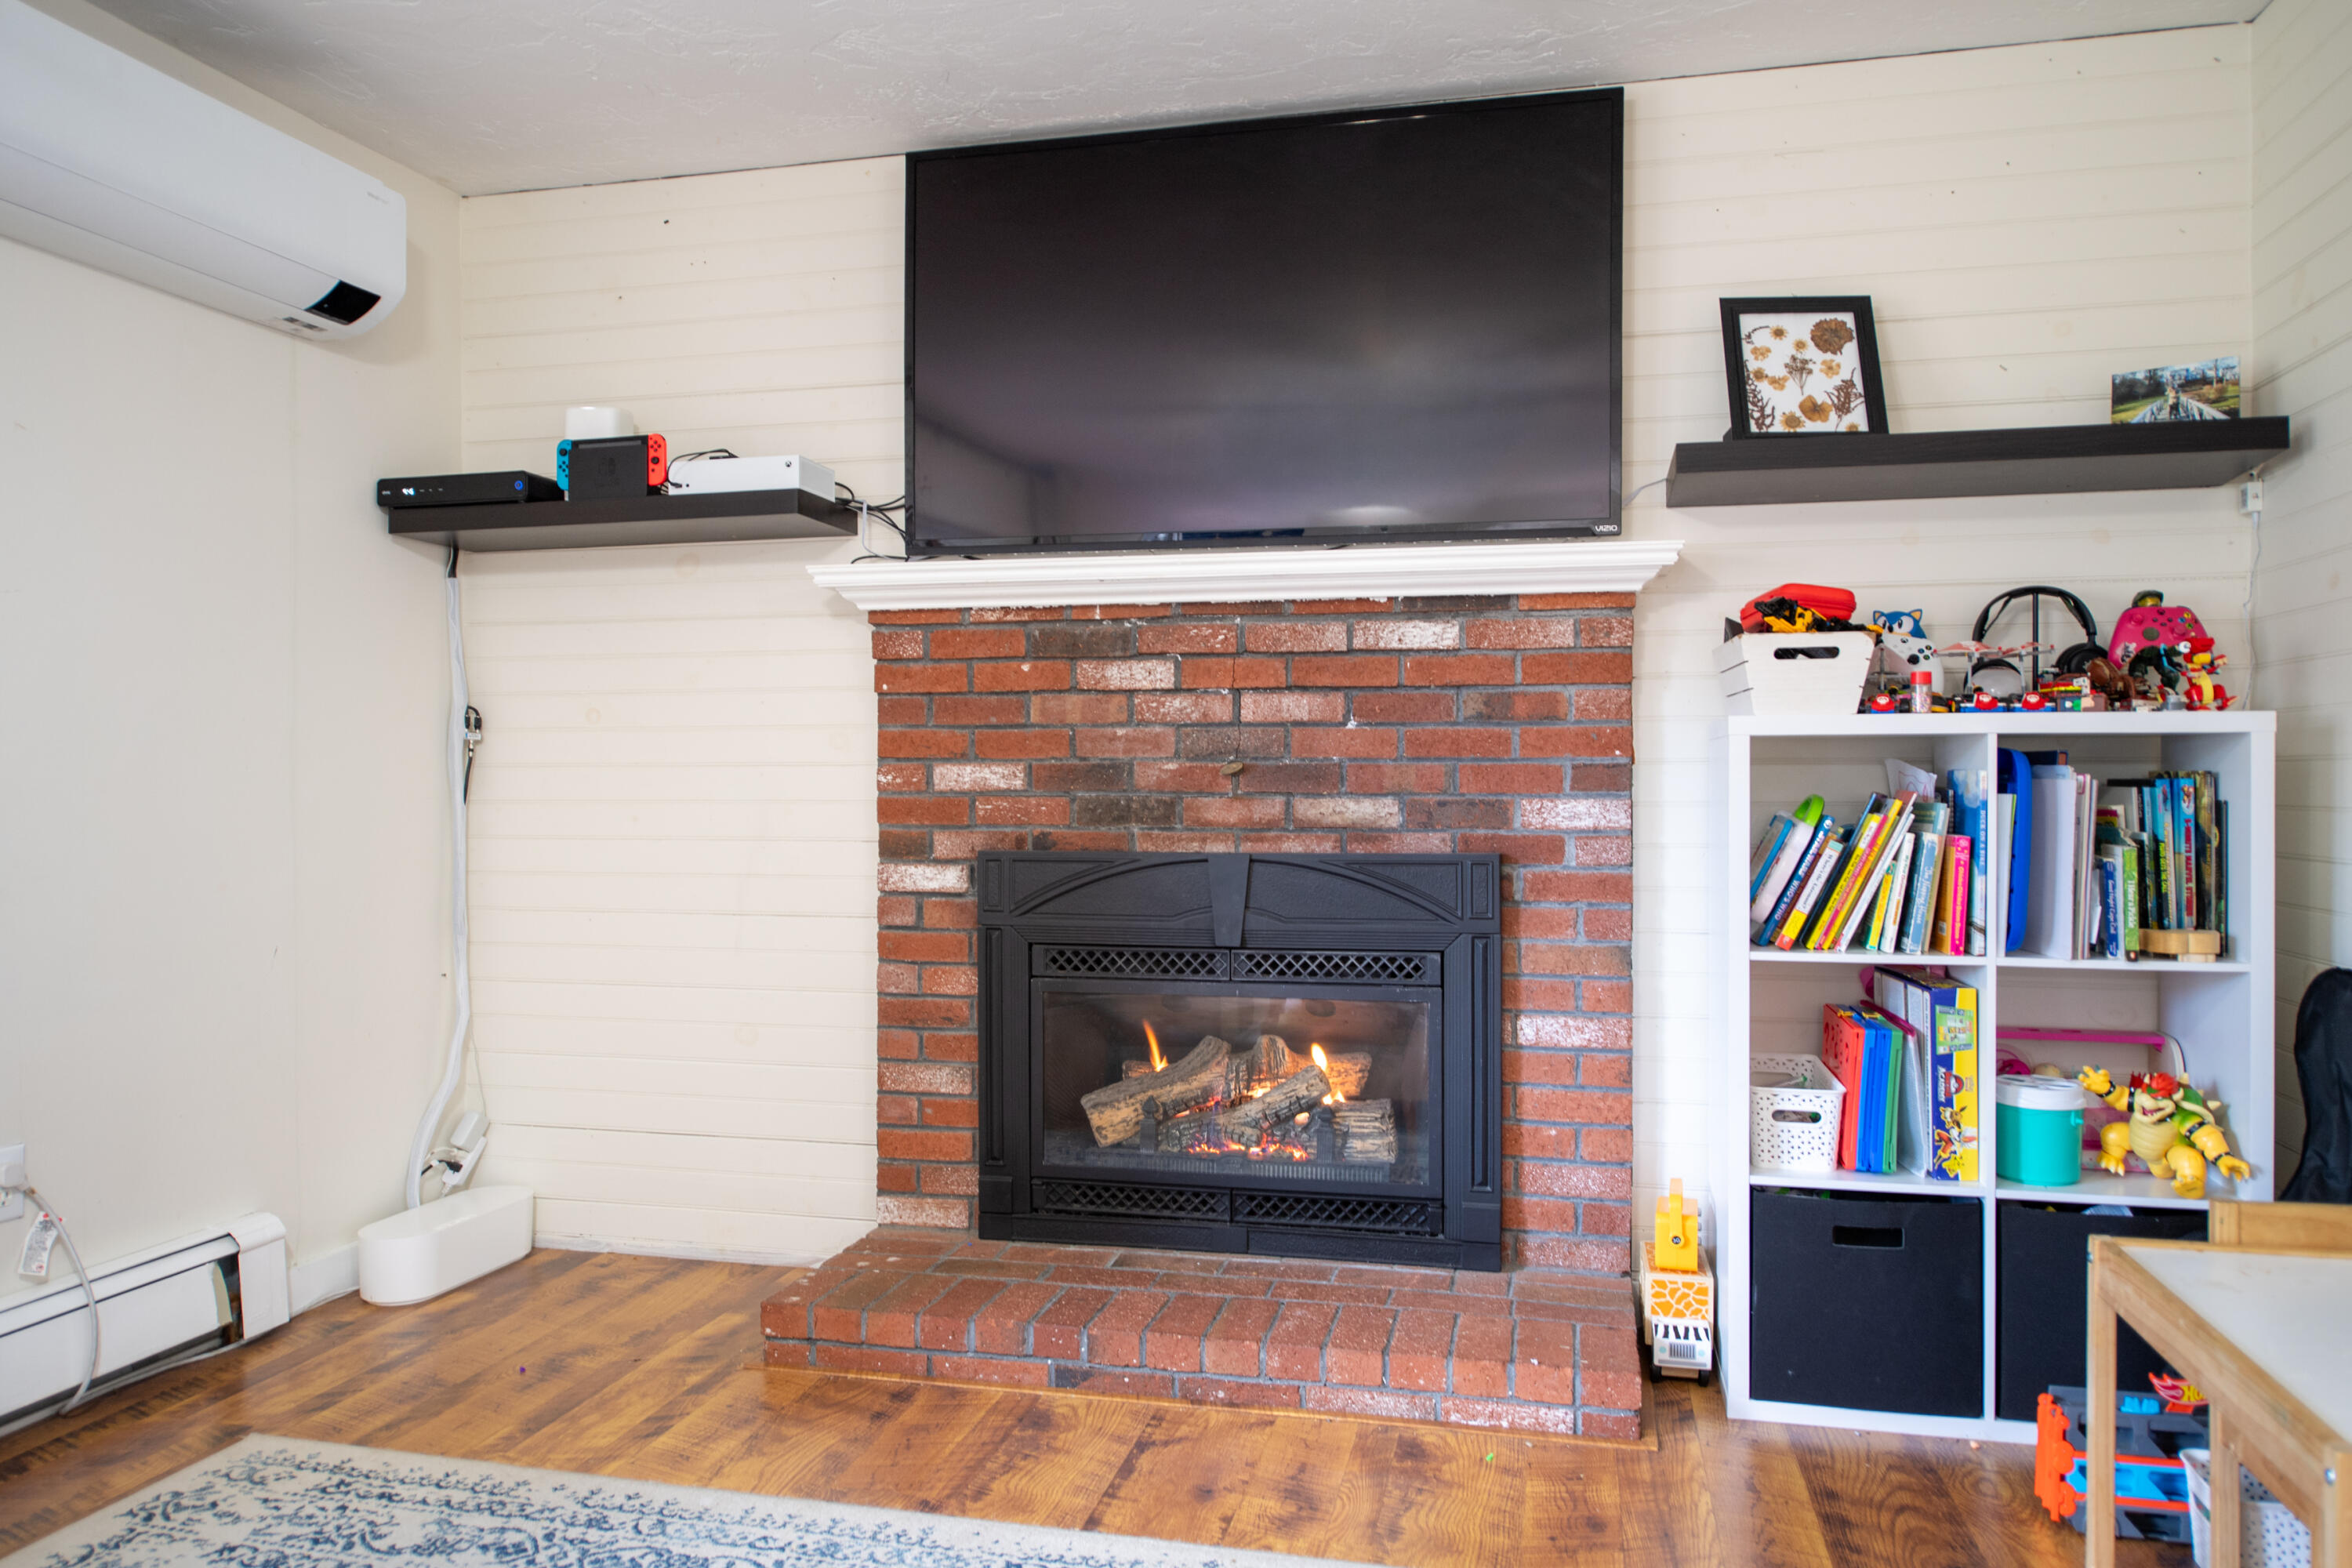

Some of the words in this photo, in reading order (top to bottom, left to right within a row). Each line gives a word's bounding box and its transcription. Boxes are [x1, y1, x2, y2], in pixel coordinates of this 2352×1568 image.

[1810, 831, 1825, 855] STAR
[1980, 830, 1985, 840] ON
[1798, 853, 1813, 876] WARS
[1923, 866, 1933, 879] The
[1785, 880, 1800, 901] WHO'S
[1916, 878, 1931, 905] Napping
[1774, 902, 1788, 920] WHO
[1916, 905, 1926, 924] House
[2107, 908, 2115, 921] Cape
[2181, 1385, 2205, 1402] HO
